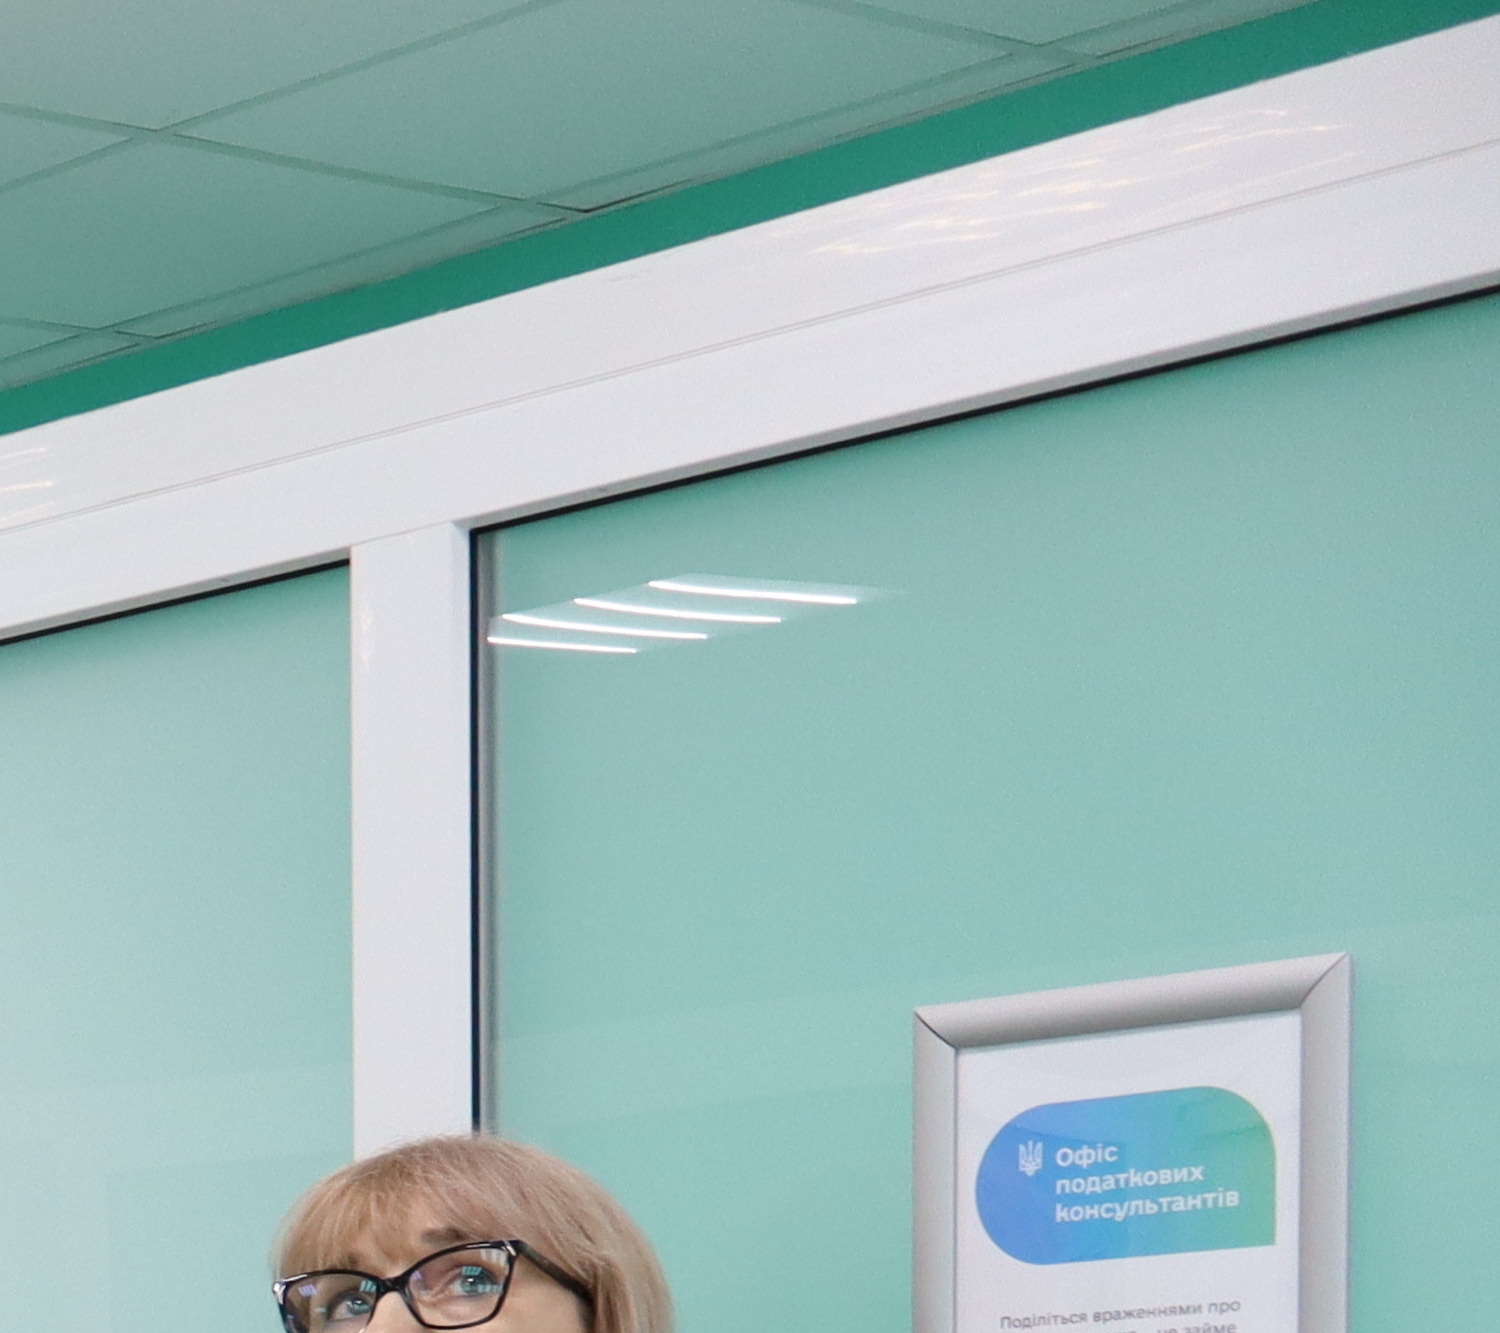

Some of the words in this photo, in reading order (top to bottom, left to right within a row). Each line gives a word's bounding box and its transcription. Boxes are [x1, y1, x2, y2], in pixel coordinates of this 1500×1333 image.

[1055, 1143, 1118, 1168] Офіс
[1055, 1166, 1205, 1195] податкових
[1055, 1188, 1240, 1222] консультантів
[999, 1312, 1087, 1331] Поділіться
[1092, 1304, 1203, 1324] враженнями
[1207, 1300, 1241, 1316] про
